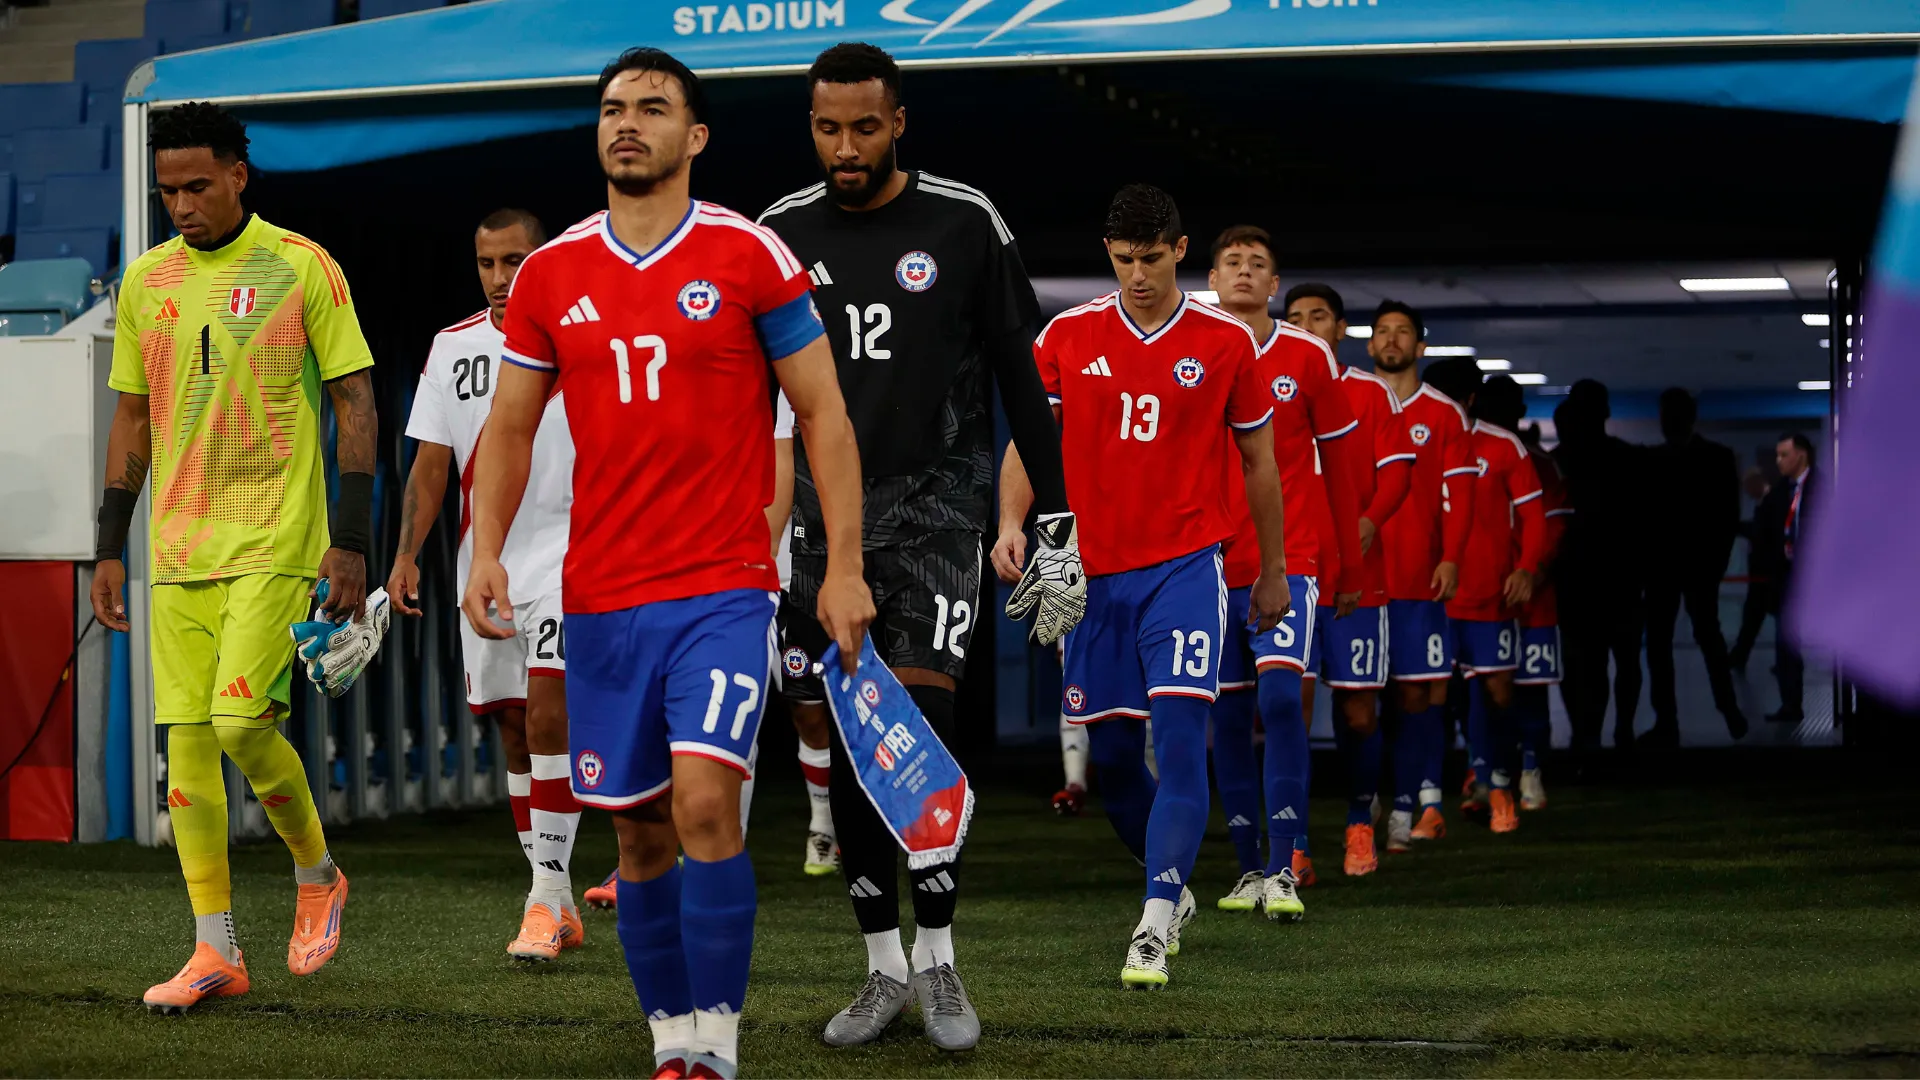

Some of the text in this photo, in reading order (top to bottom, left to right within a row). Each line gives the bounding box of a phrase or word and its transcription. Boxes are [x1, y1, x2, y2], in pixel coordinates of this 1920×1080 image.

[673, 0, 845, 36] STADIUM
[201, 324, 210, 375] 1
[845, 303, 892, 360] 12
[452, 354, 491, 401] 20
[609, 334, 668, 404] 17
[1120, 391, 1161, 442] 13
[1036, 525, 1056, 547] uhlsport
[1014, 572, 1035, 601] uhlsport
[932, 593, 971, 659] 12
[1497, 628, 1511, 661] 9
[1171, 629, 1211, 678] 13
[1350, 637, 1375, 677] 21
[1426, 632, 1445, 668] 8
[1525, 643, 1556, 675] 24
[702, 668, 760, 741] 17
[883, 722, 917, 760] PER
[304, 935, 338, 967] F50
